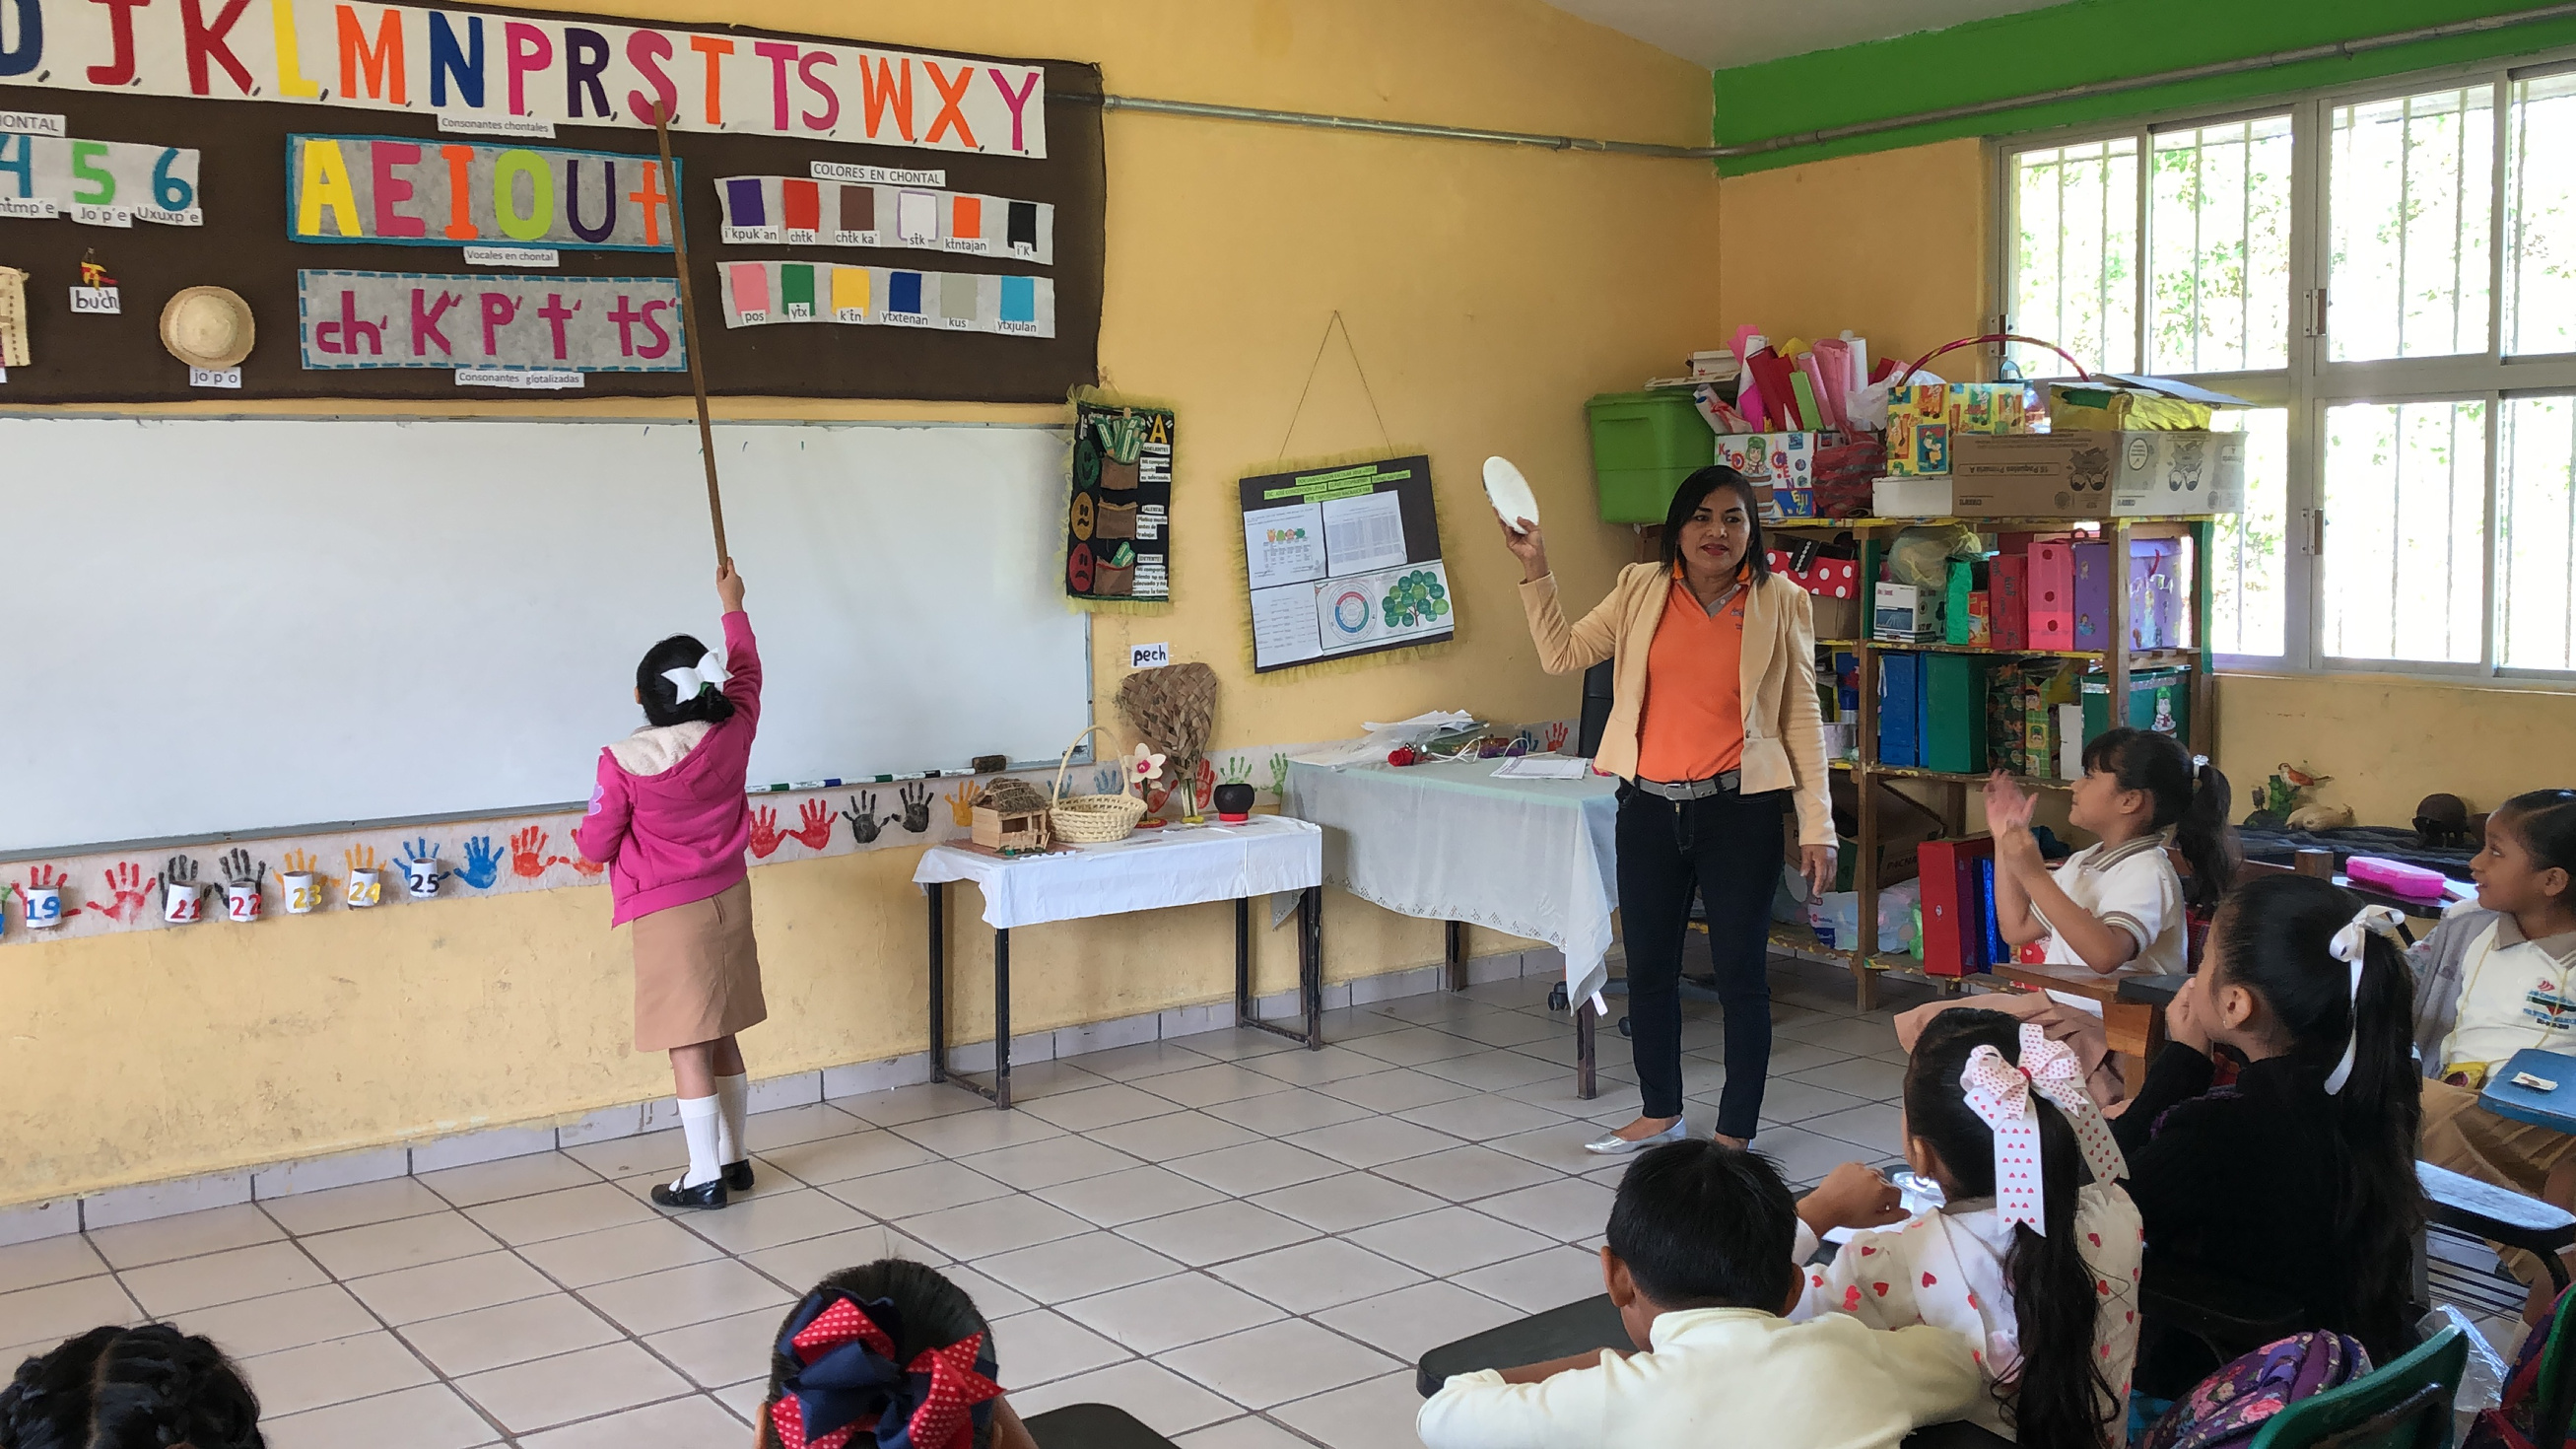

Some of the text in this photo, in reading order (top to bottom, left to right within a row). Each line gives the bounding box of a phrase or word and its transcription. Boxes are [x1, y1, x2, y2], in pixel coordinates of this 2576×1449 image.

[0, 115, 59, 132] ONTAL
[441, 117, 549, 132] Consonantes chontales
[73, 140, 115, 205] 5
[153, 147, 192, 211] 6
[814, 163, 940, 184] COLORES EN CHONTAL
[298, 139, 363, 237] A
[371, 141, 426, 238] E
[441, 145, 479, 241] I
[494, 149, 554, 241] O
[566, 160, 616, 242] U
[466, 250, 503, 260] Vocales
[519, 252, 554, 261] chontal
[745, 312, 765, 322] pos
[948, 318, 967, 328] kus
[459, 373, 579, 384] Consonantes glotalizadas
[1133, 645, 1166, 666] pech
[350, 882, 381, 903] 24
[410, 873, 440, 893] 25
[231, 894, 262, 916] 22
[294, 885, 322, 909] 23
[27, 896, 61, 920] 19
[170, 898, 202, 919] 21
